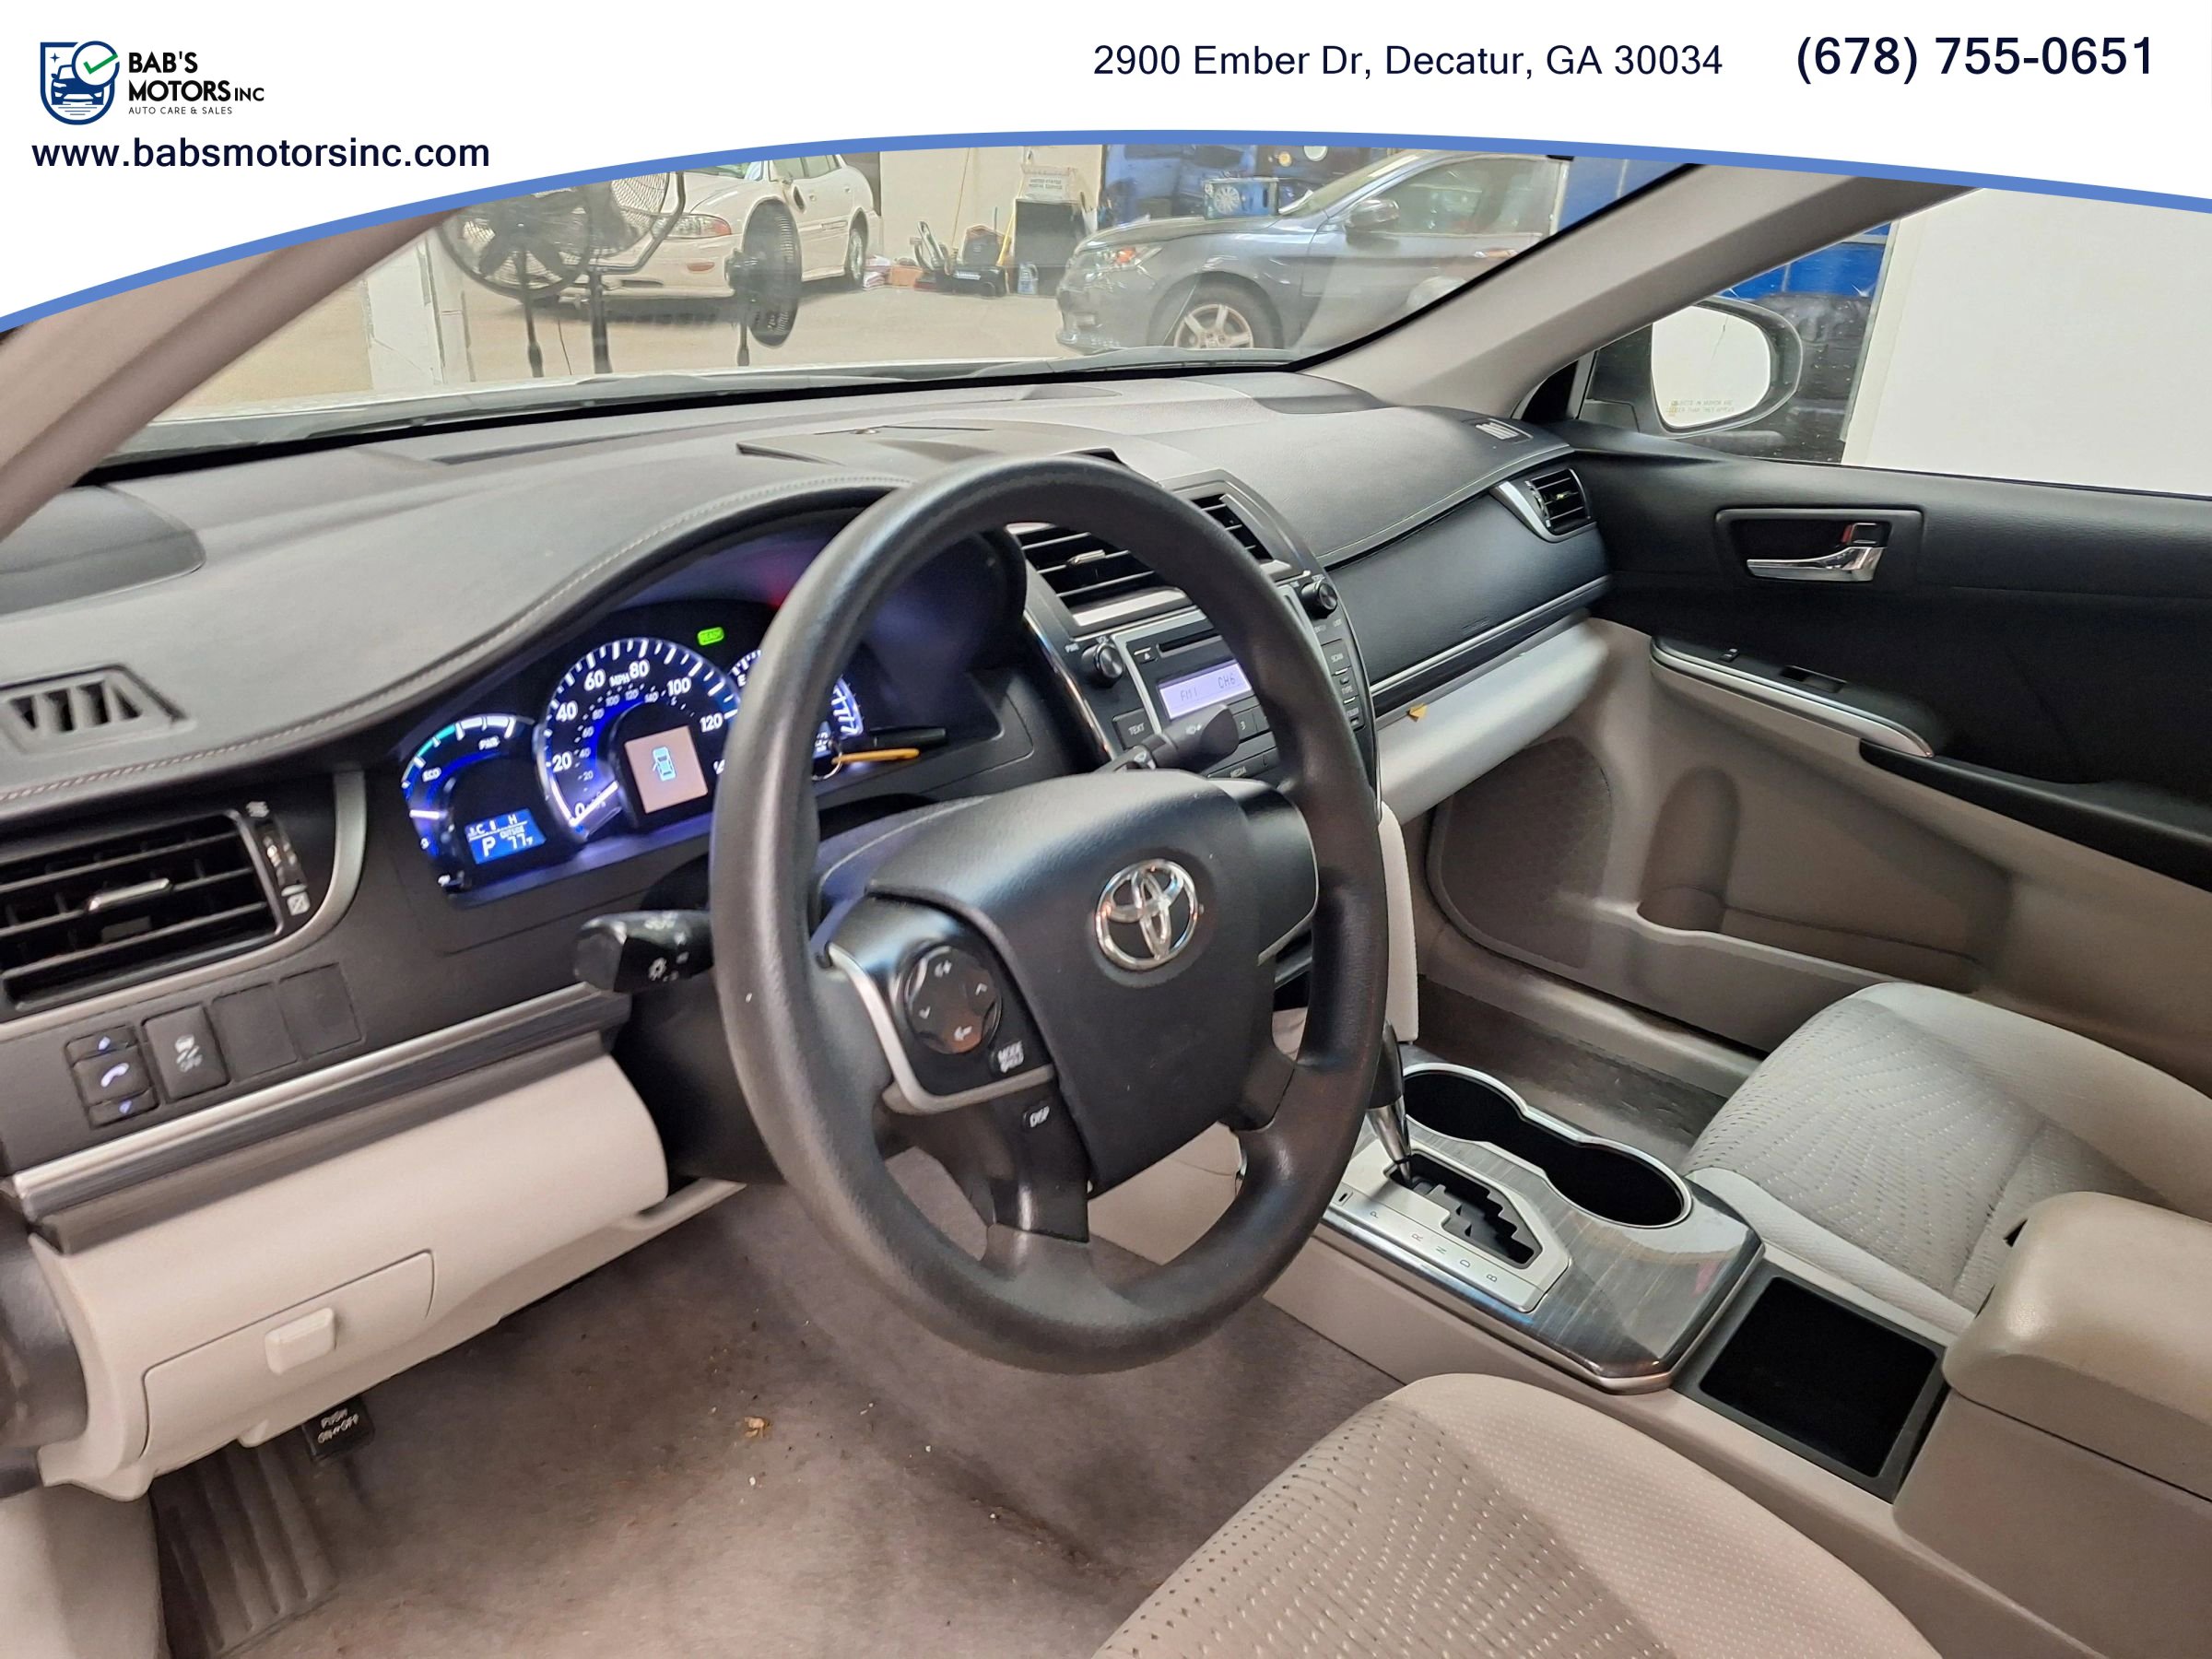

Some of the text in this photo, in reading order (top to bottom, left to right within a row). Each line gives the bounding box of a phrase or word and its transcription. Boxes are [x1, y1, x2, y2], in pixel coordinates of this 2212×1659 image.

[629, 659, 650, 678] 80
[584, 668, 606, 690] 60
[609, 672, 629, 688] MPH
[667, 677, 691, 695] 100
[606, 694, 620, 708] 100
[625, 688, 639, 701] 120
[556, 700, 578, 722] 40
[699, 713, 724, 733] 120
[1128, 723, 1145, 735] TEXT
[1240, 721, 1246, 731] 3
[552, 751, 572, 772] 20
[583, 770, 594, 782] 20
[476, 814, 518, 834] C H
[481, 836, 496, 857] P
[1370, 1210, 1498, 1283] P R N D B
